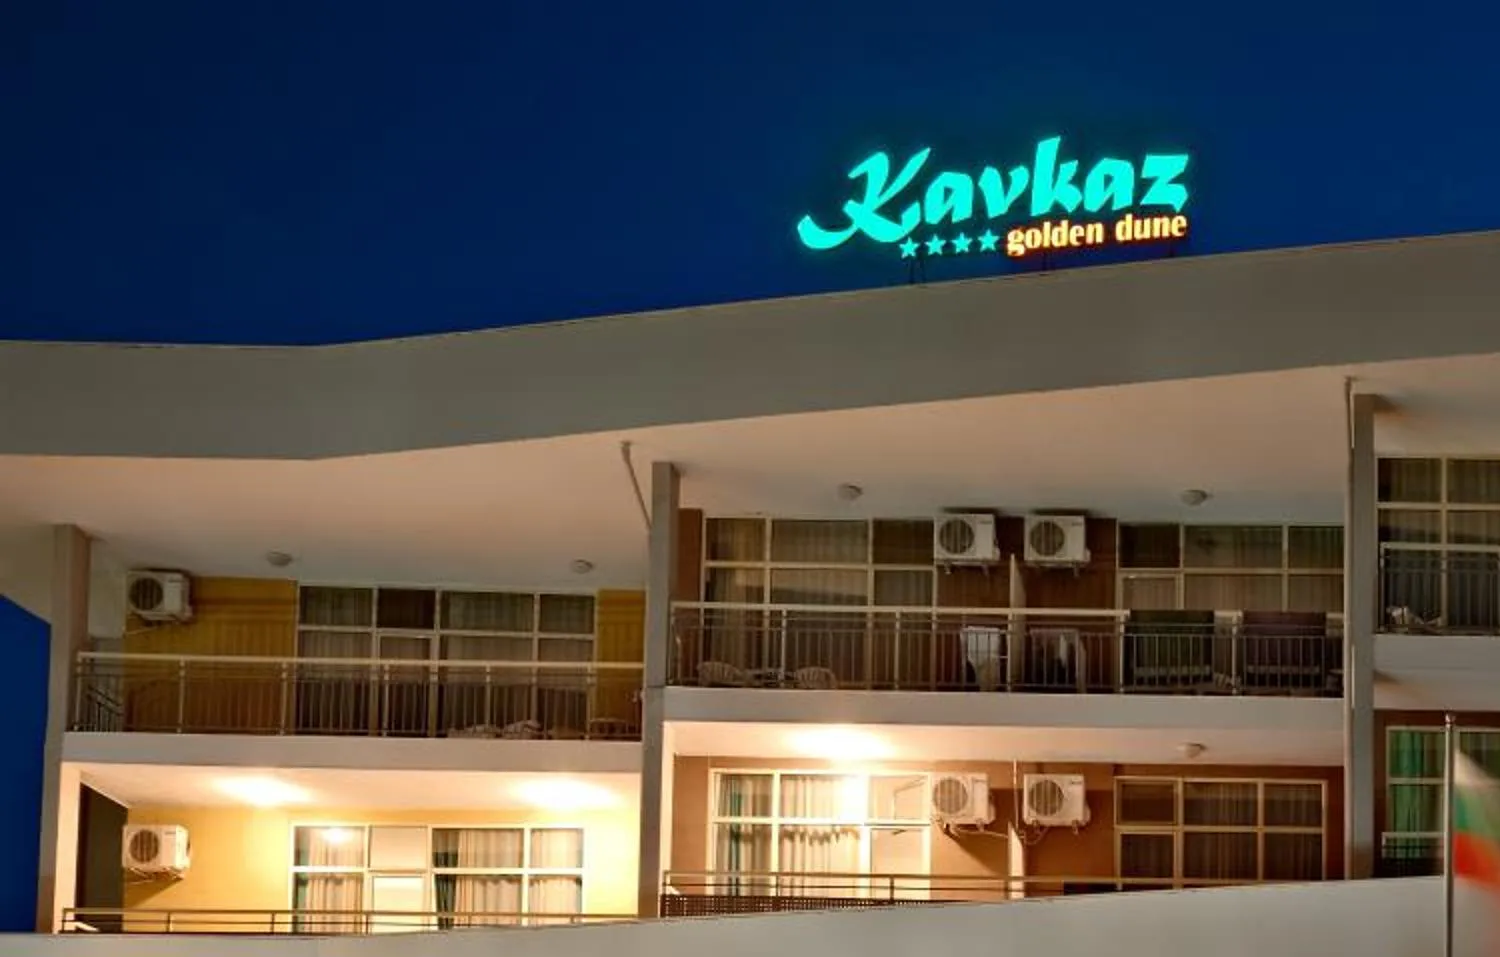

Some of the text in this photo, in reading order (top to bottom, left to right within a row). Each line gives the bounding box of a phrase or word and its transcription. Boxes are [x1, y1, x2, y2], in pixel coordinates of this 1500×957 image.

[798, 136, 1189, 249] Kavkaz
[1007, 214, 1188, 256] golden dune
